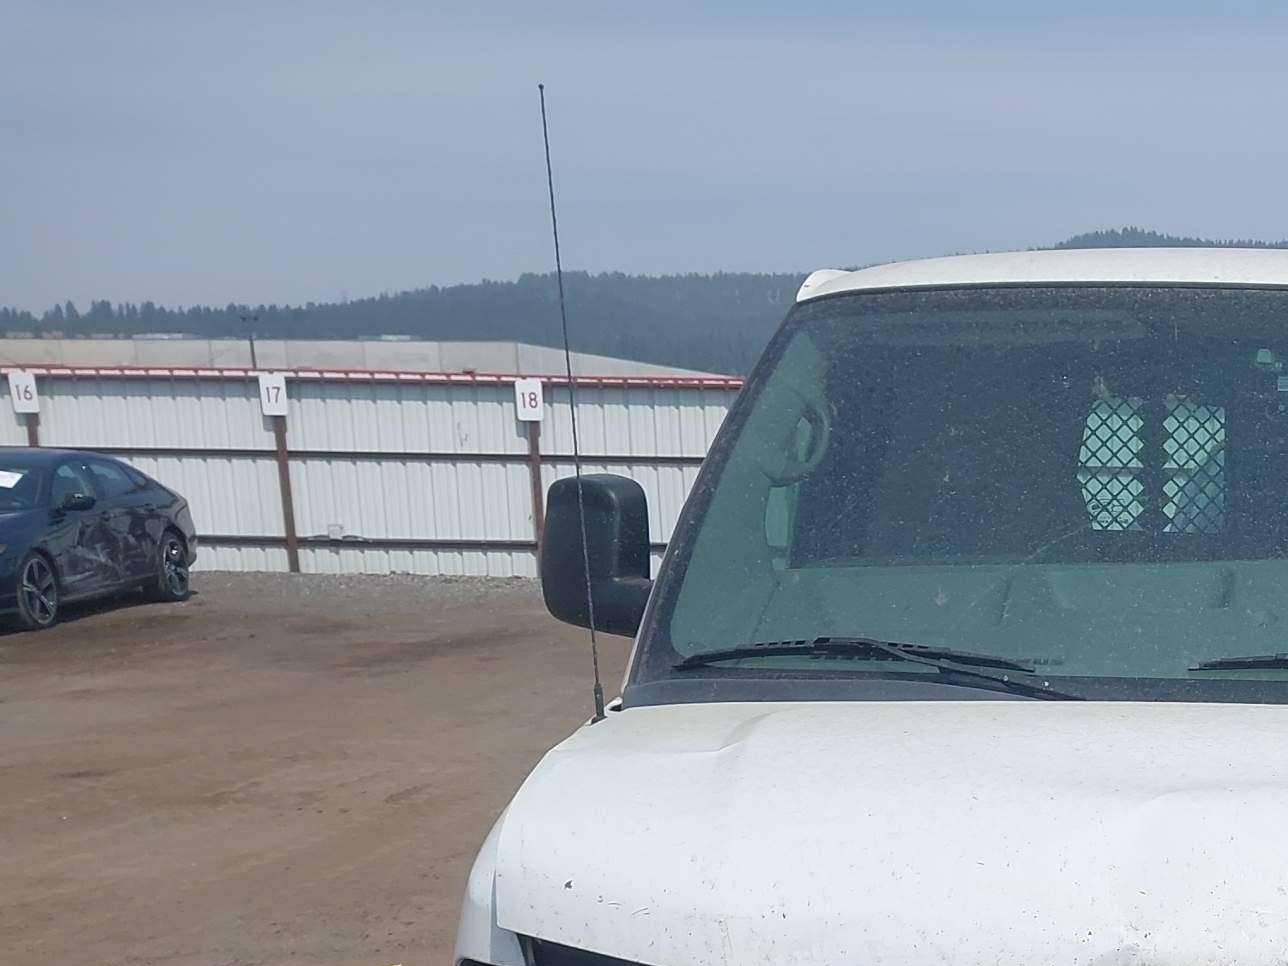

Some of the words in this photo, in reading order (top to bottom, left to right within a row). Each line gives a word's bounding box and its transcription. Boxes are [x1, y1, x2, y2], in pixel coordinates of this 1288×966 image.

[15, 385, 33, 401] 16
[265, 386, 281, 404] 17
[521, 391, 539, 409] 18
